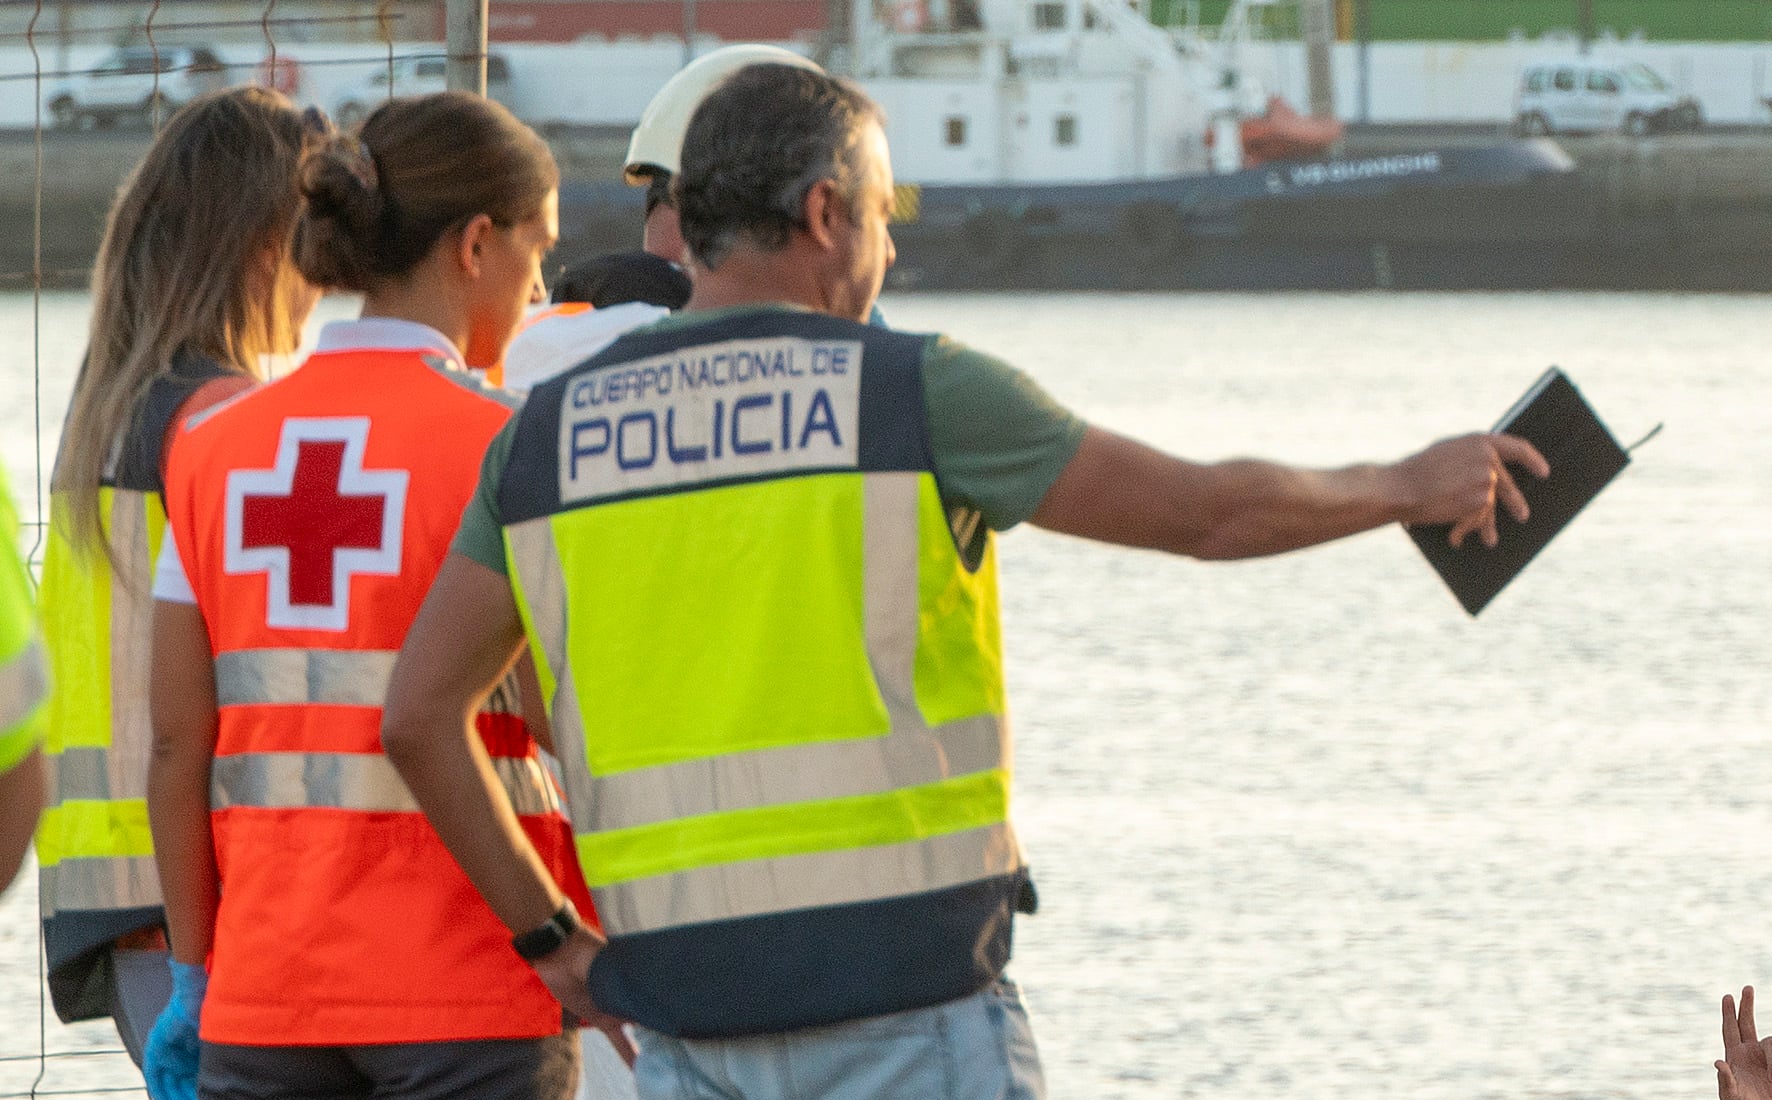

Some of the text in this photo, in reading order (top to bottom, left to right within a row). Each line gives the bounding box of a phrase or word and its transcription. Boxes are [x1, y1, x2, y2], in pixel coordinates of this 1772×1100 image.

[573, 346, 850, 409] CUERPO NACIONAL DE
[568, 387, 844, 481] POLICIA
